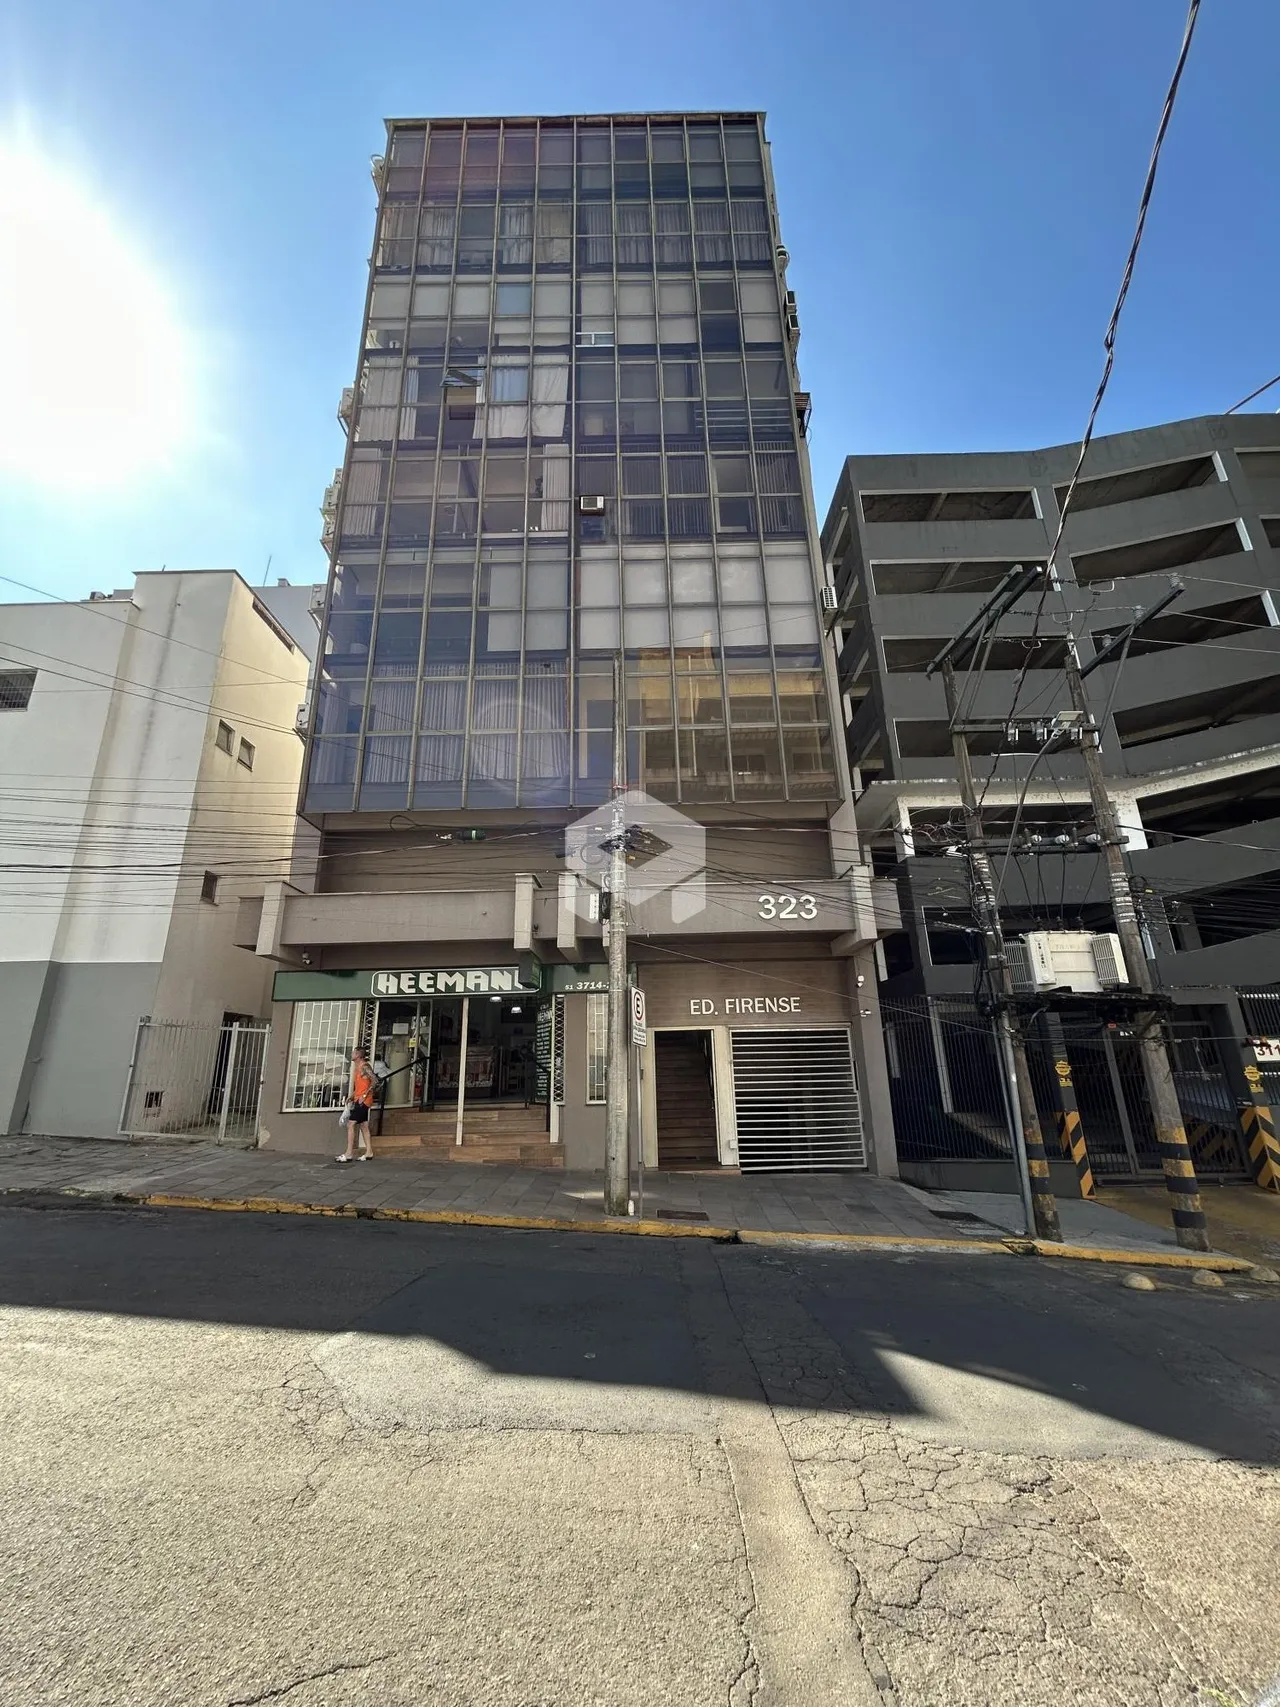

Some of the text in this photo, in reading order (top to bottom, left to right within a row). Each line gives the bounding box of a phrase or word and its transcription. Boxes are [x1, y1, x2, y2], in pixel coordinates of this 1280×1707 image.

[758, 894, 818, 919] 323
[576, 981, 609, 990] 3714-
[690, 997, 802, 1015] ED. FIRENSE
